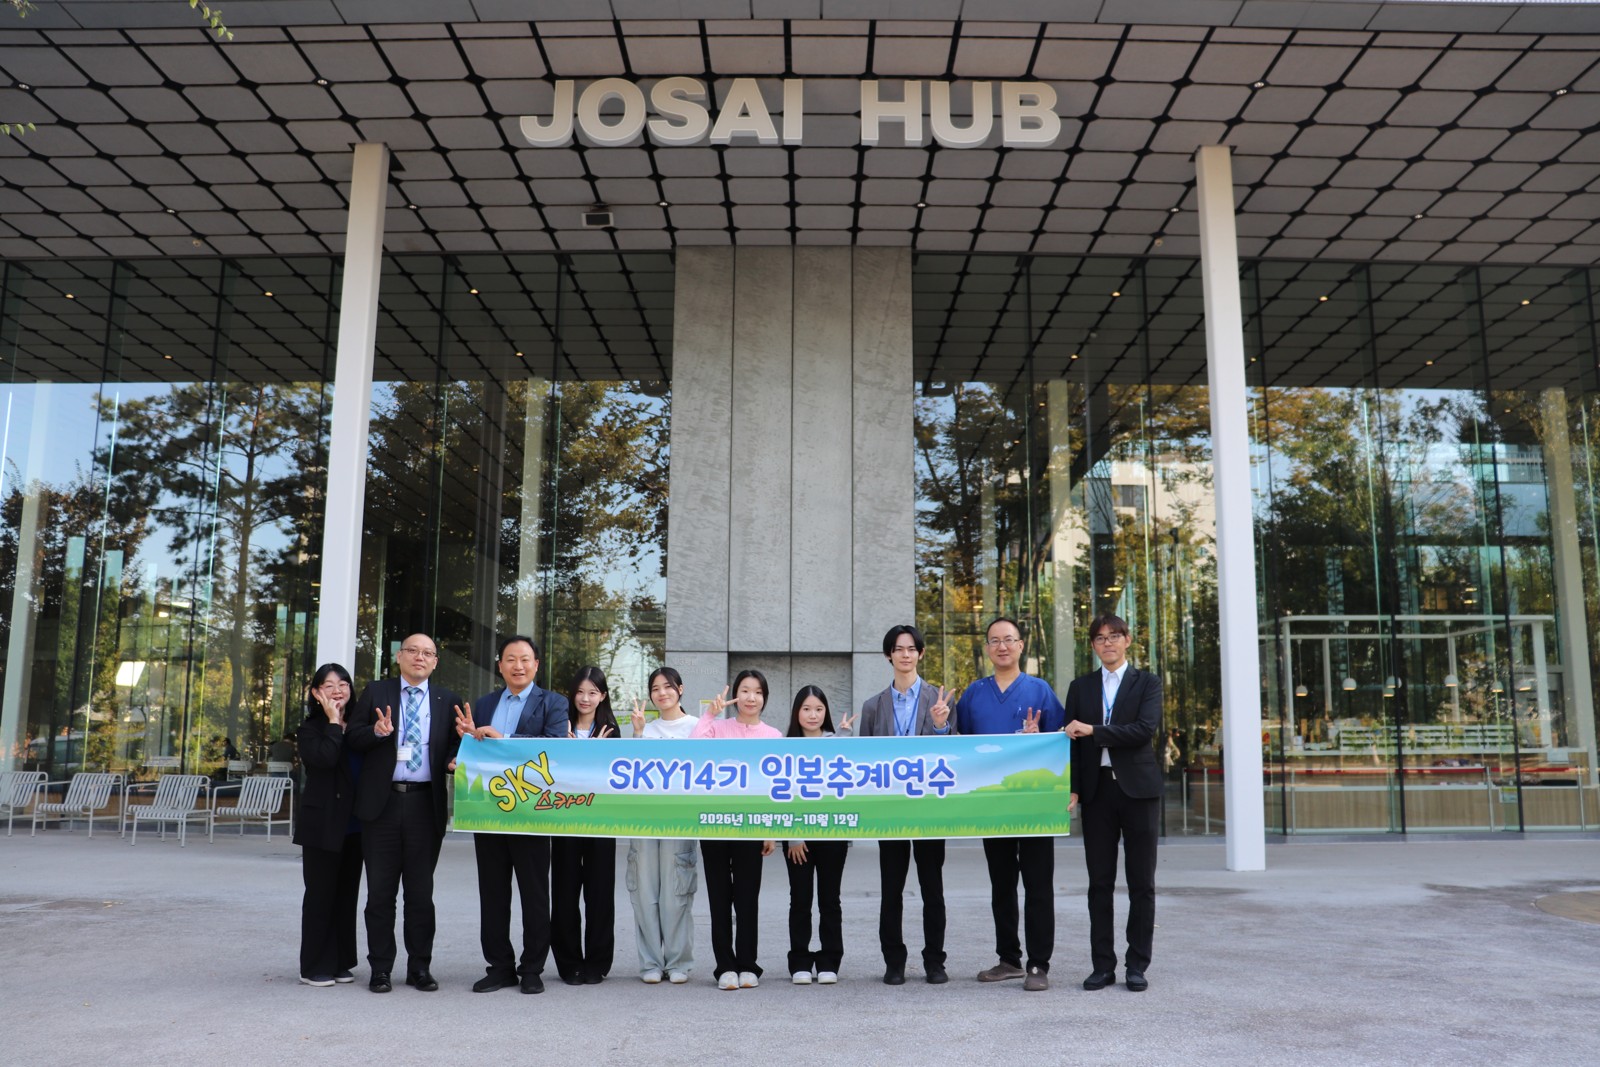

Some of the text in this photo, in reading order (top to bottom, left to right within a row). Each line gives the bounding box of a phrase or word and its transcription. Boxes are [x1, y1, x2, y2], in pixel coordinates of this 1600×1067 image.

[519, 77, 1063, 149] JOSAI HUB
[488, 750, 556, 813] SKY
[534, 789, 596, 811] 스카이
[609, 755, 956, 800] SKY14기 일본추계연수
[747, 812, 829, 828] 10월7일~10월
[832, 812, 859, 828] 12일
